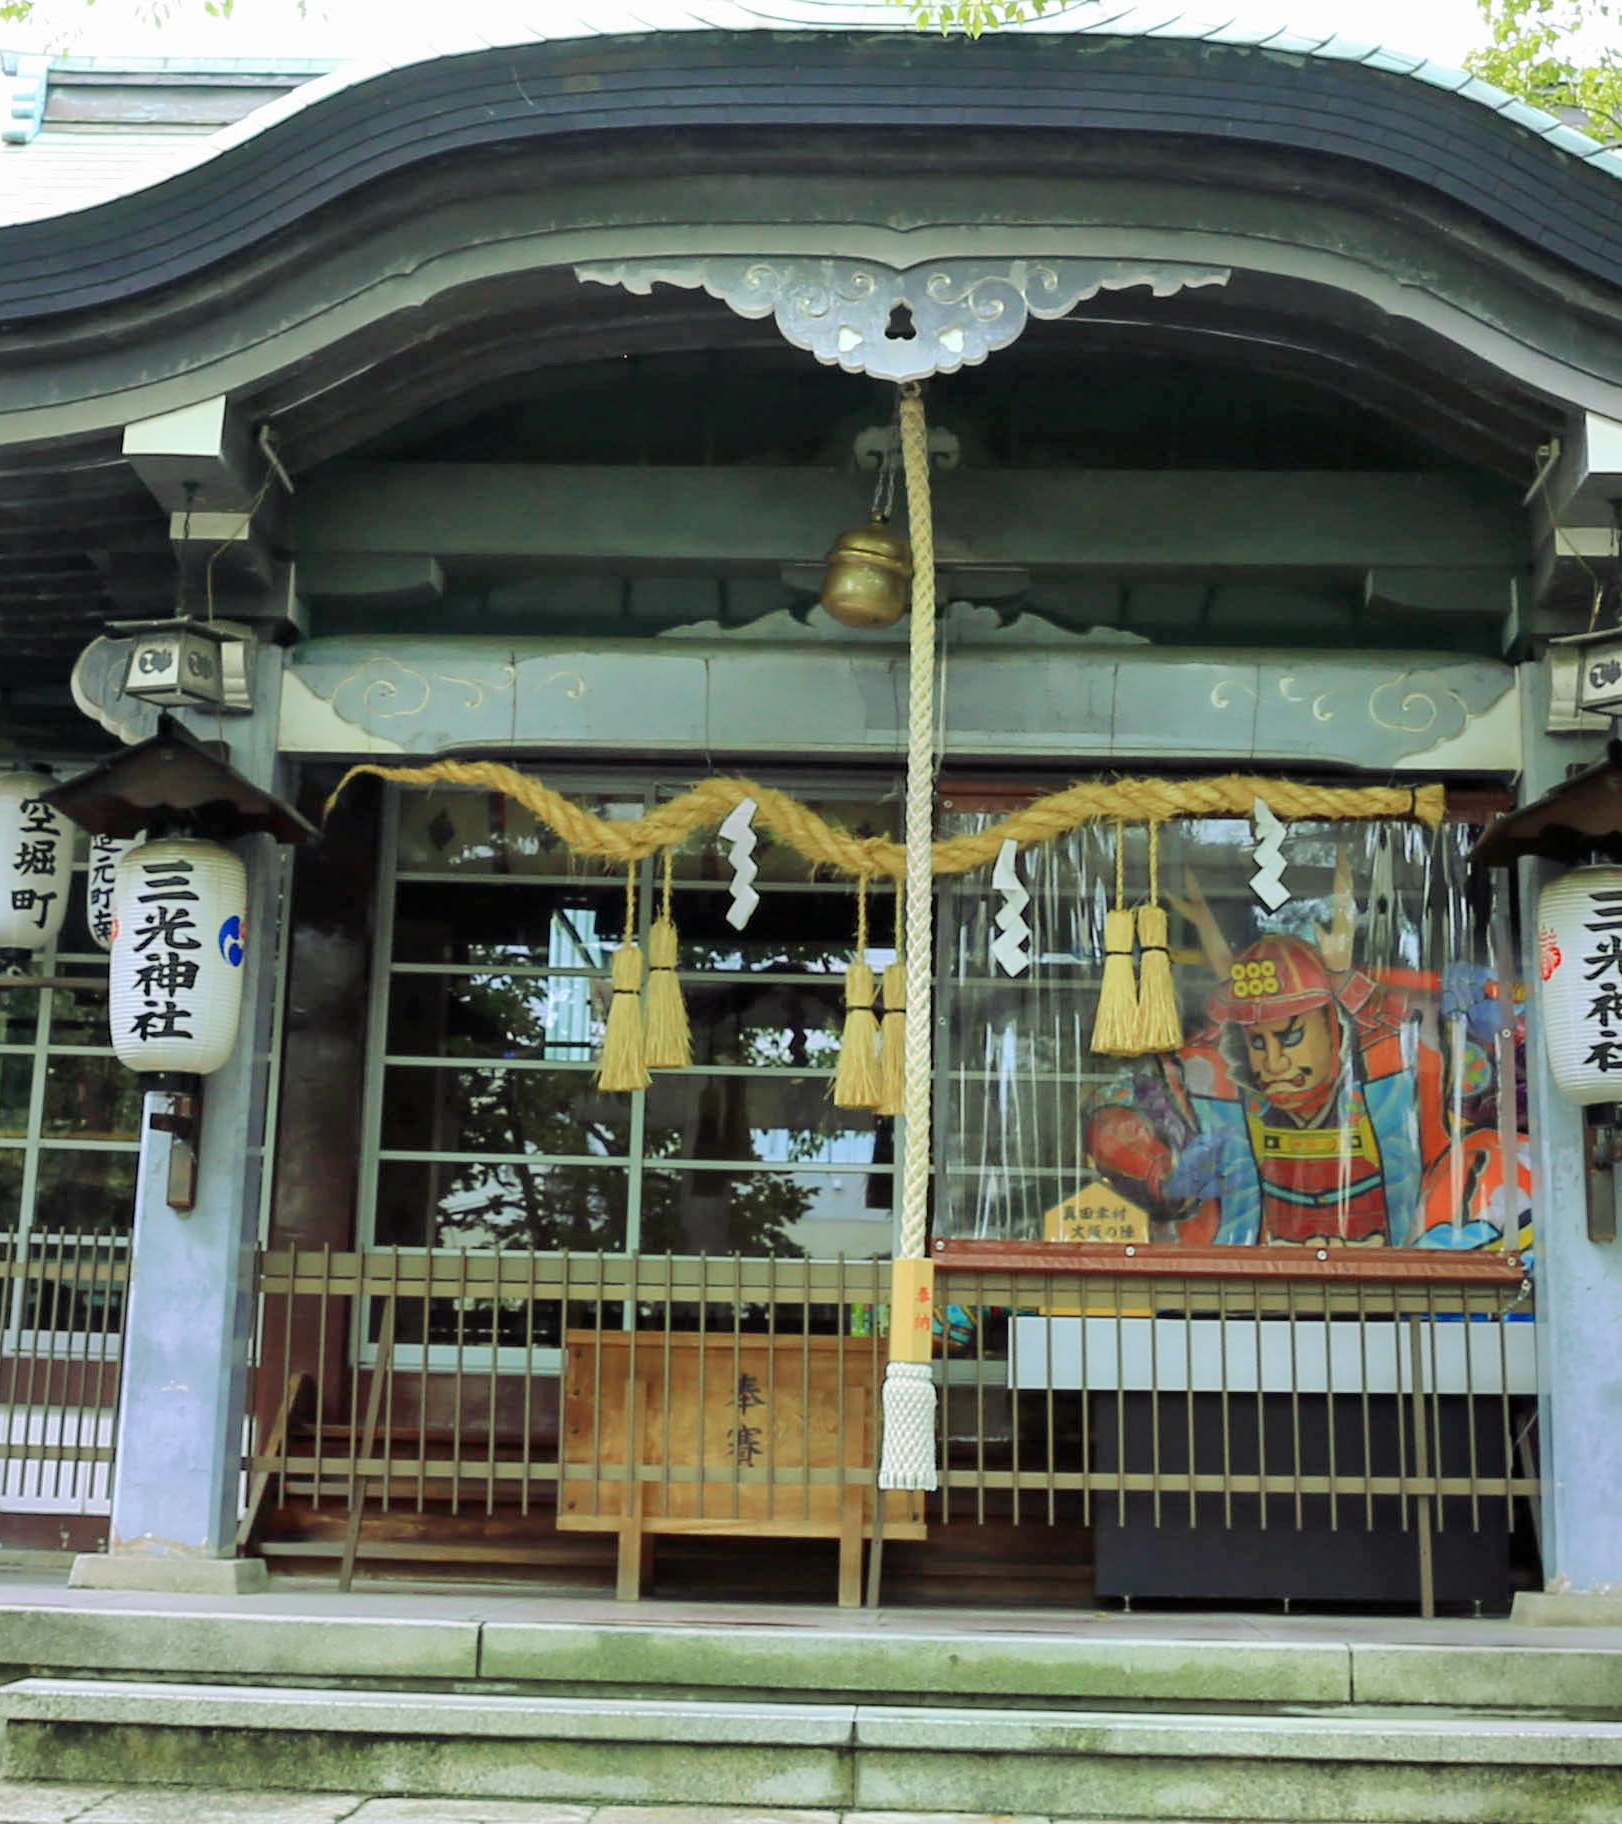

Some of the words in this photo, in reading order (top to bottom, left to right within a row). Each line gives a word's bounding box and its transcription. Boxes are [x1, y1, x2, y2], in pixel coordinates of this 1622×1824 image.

[11, 797, 61, 927] 空堀町
[130, 859, 202, 1041] 三光神社
